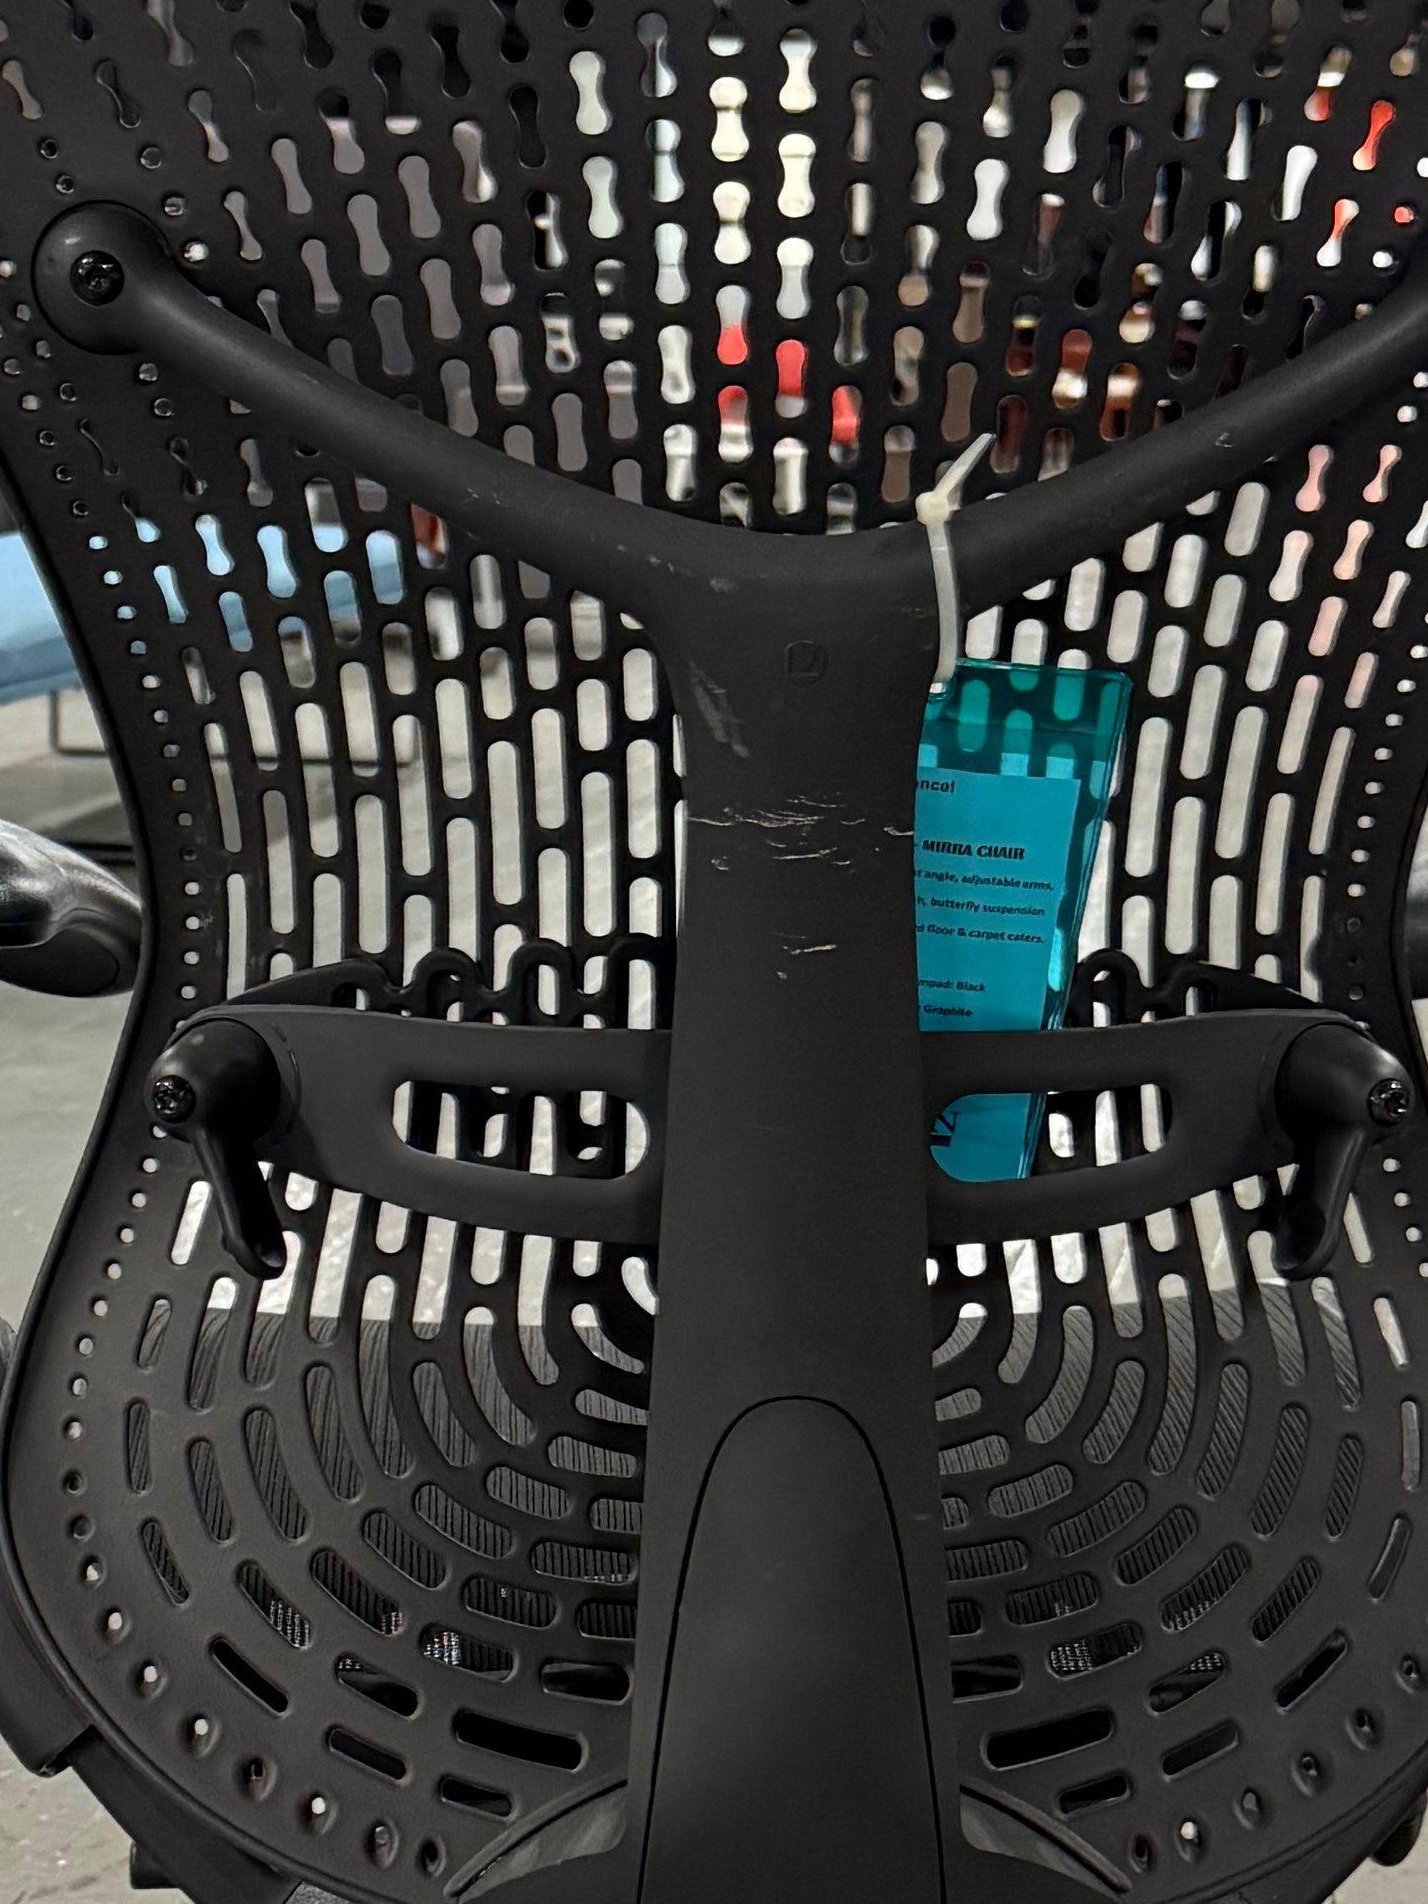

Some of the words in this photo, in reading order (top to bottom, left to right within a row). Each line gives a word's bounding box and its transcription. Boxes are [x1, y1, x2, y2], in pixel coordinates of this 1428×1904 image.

[922, 839, 973, 857] MIRRA
[976, 844, 1026, 860] CHAIR
[924, 869, 959, 884] angle,
[961, 874, 1021, 889] adjustable
[930, 897, 980, 913] butterfly
[982, 903, 1046, 916] suspension
[927, 923, 954, 936] floor
[957, 927, 966, 937] &
[968, 928, 1005, 941] carpet
[956, 981, 986, 992] Black
[923, 1004, 973, 1017] Graphite
